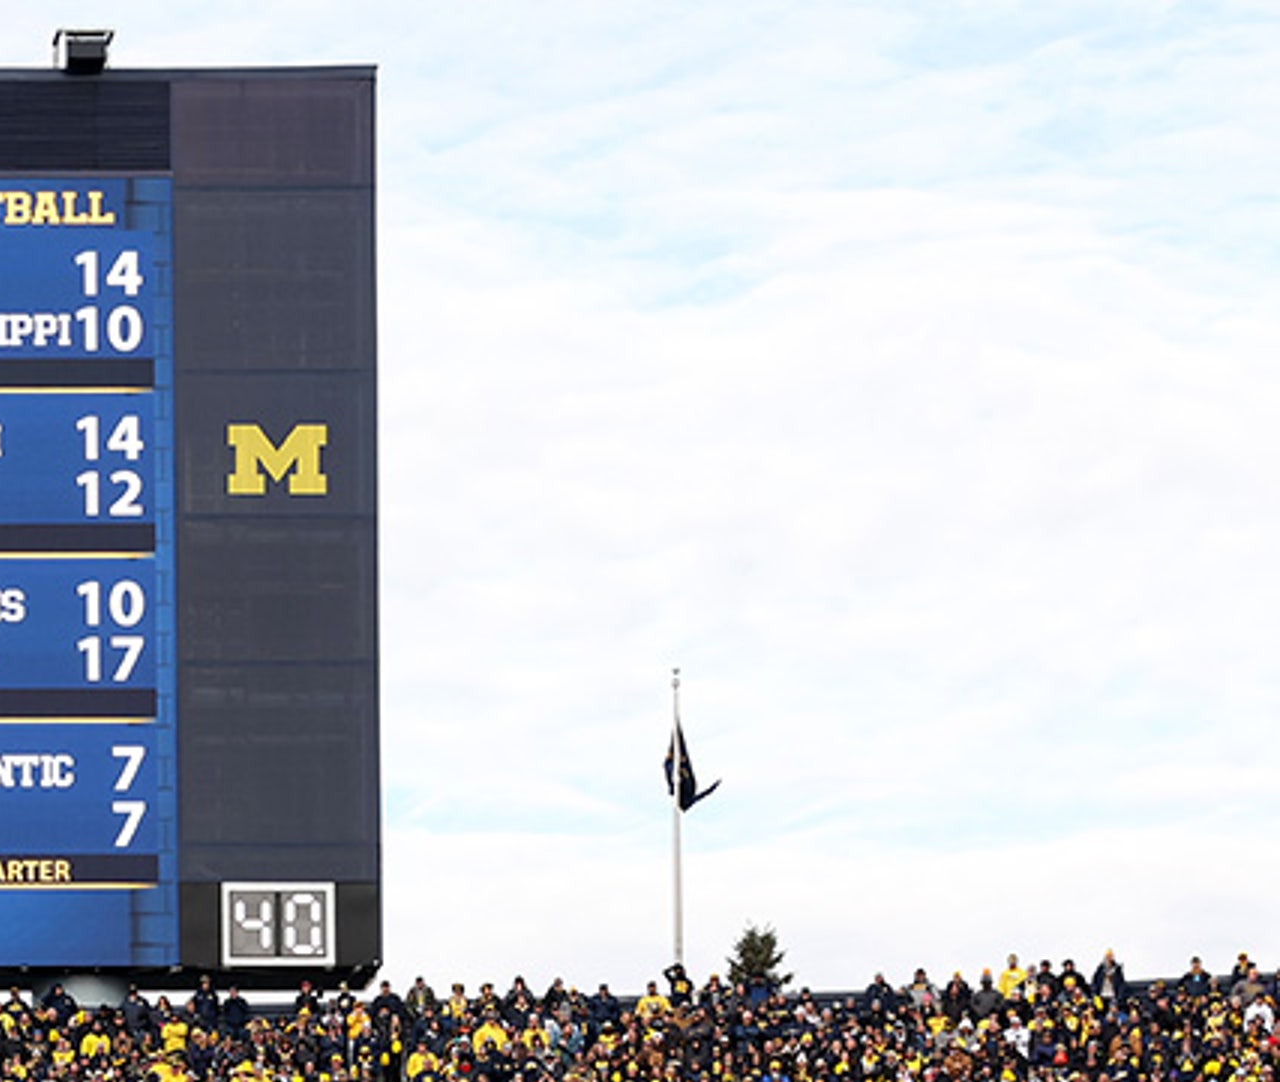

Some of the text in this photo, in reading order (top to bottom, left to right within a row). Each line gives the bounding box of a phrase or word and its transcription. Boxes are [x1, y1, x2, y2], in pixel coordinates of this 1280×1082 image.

[74, 250, 143, 296] 14
[75, 305, 143, 352] 10
[76, 414, 144, 461] 14
[227, 424, 328, 495] M
[76, 470, 144, 517] 12
[76, 581, 145, 627] 10
[76, 635, 145, 682] 17
[111, 745, 146, 792] 7
[111, 801, 146, 847] 7
[234, 893, 322, 955] 40
